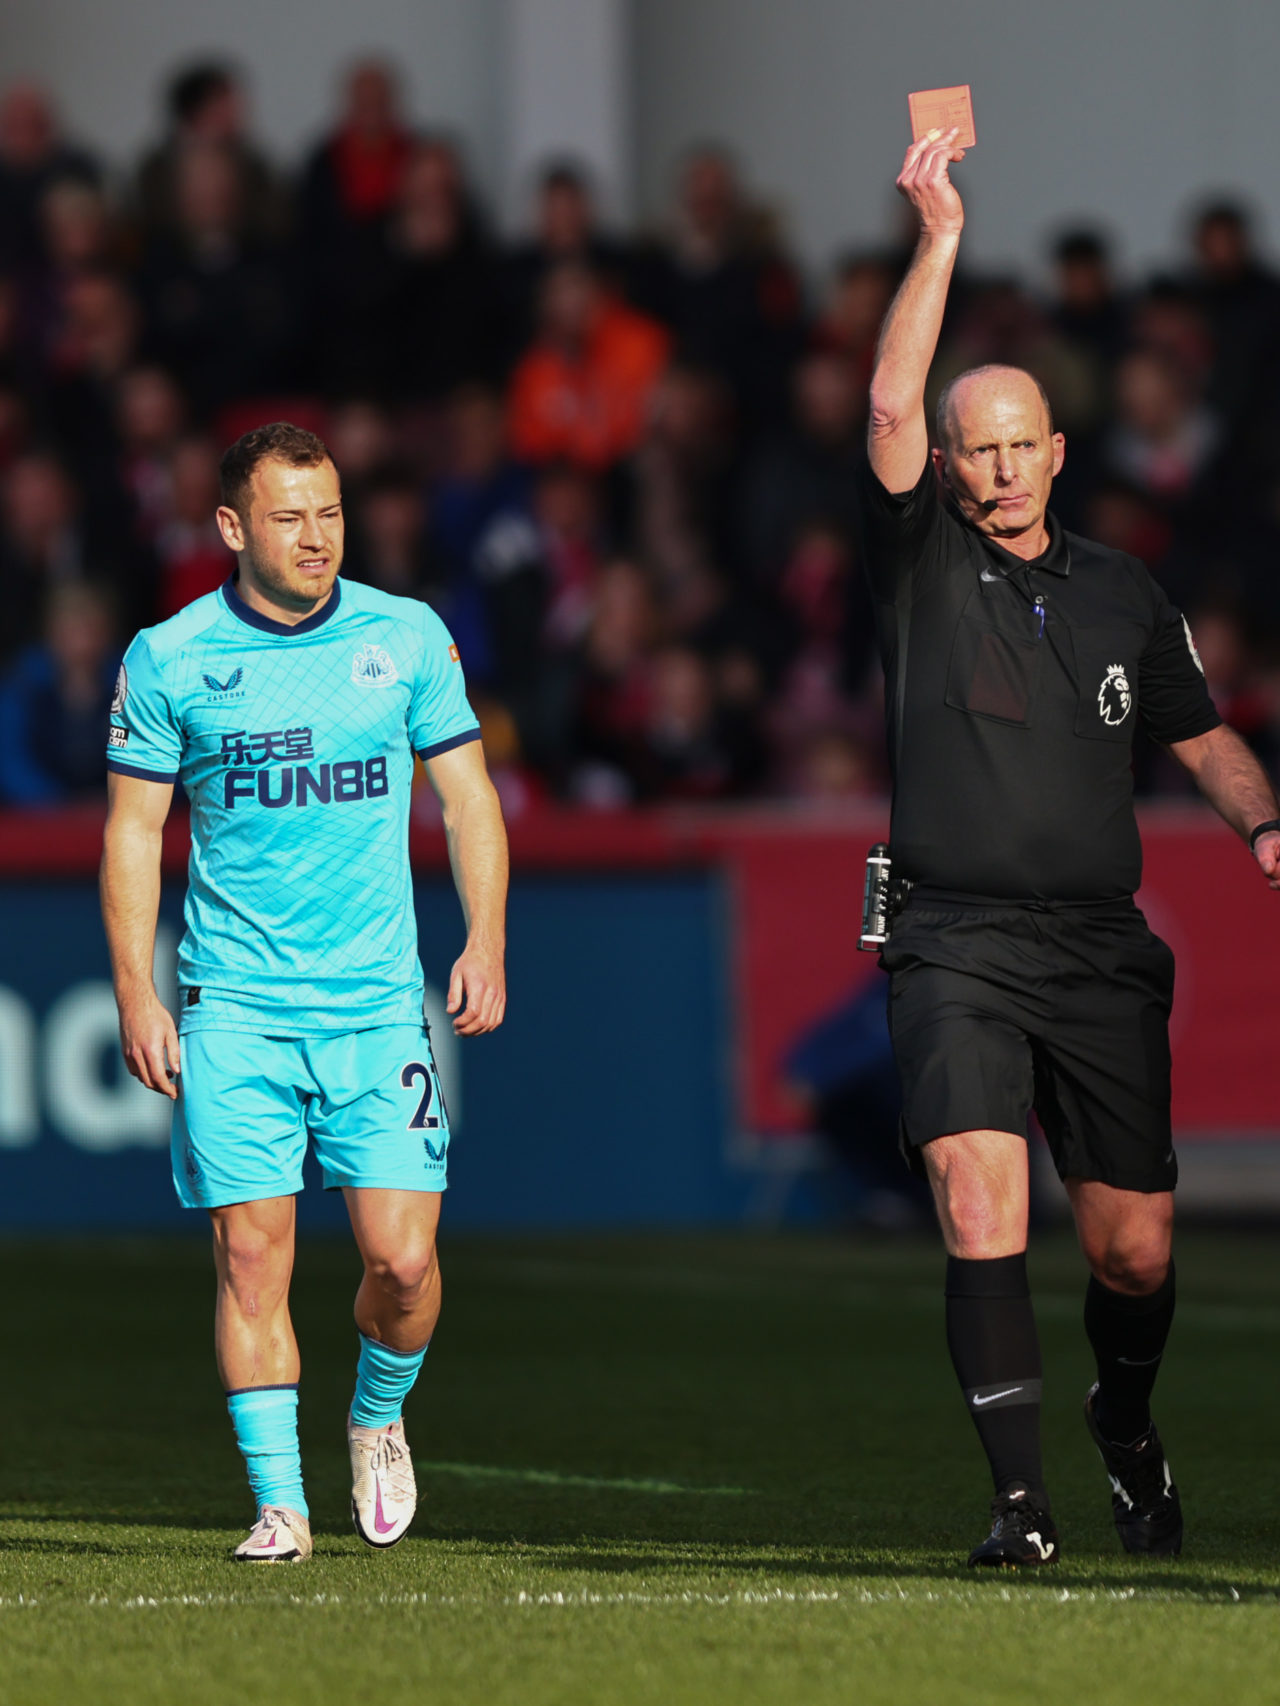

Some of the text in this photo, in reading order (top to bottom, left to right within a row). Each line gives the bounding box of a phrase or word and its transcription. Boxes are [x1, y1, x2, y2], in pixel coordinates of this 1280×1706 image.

[221, 727, 314, 766] 乐天堂
[224, 756, 389, 809] FUN88
